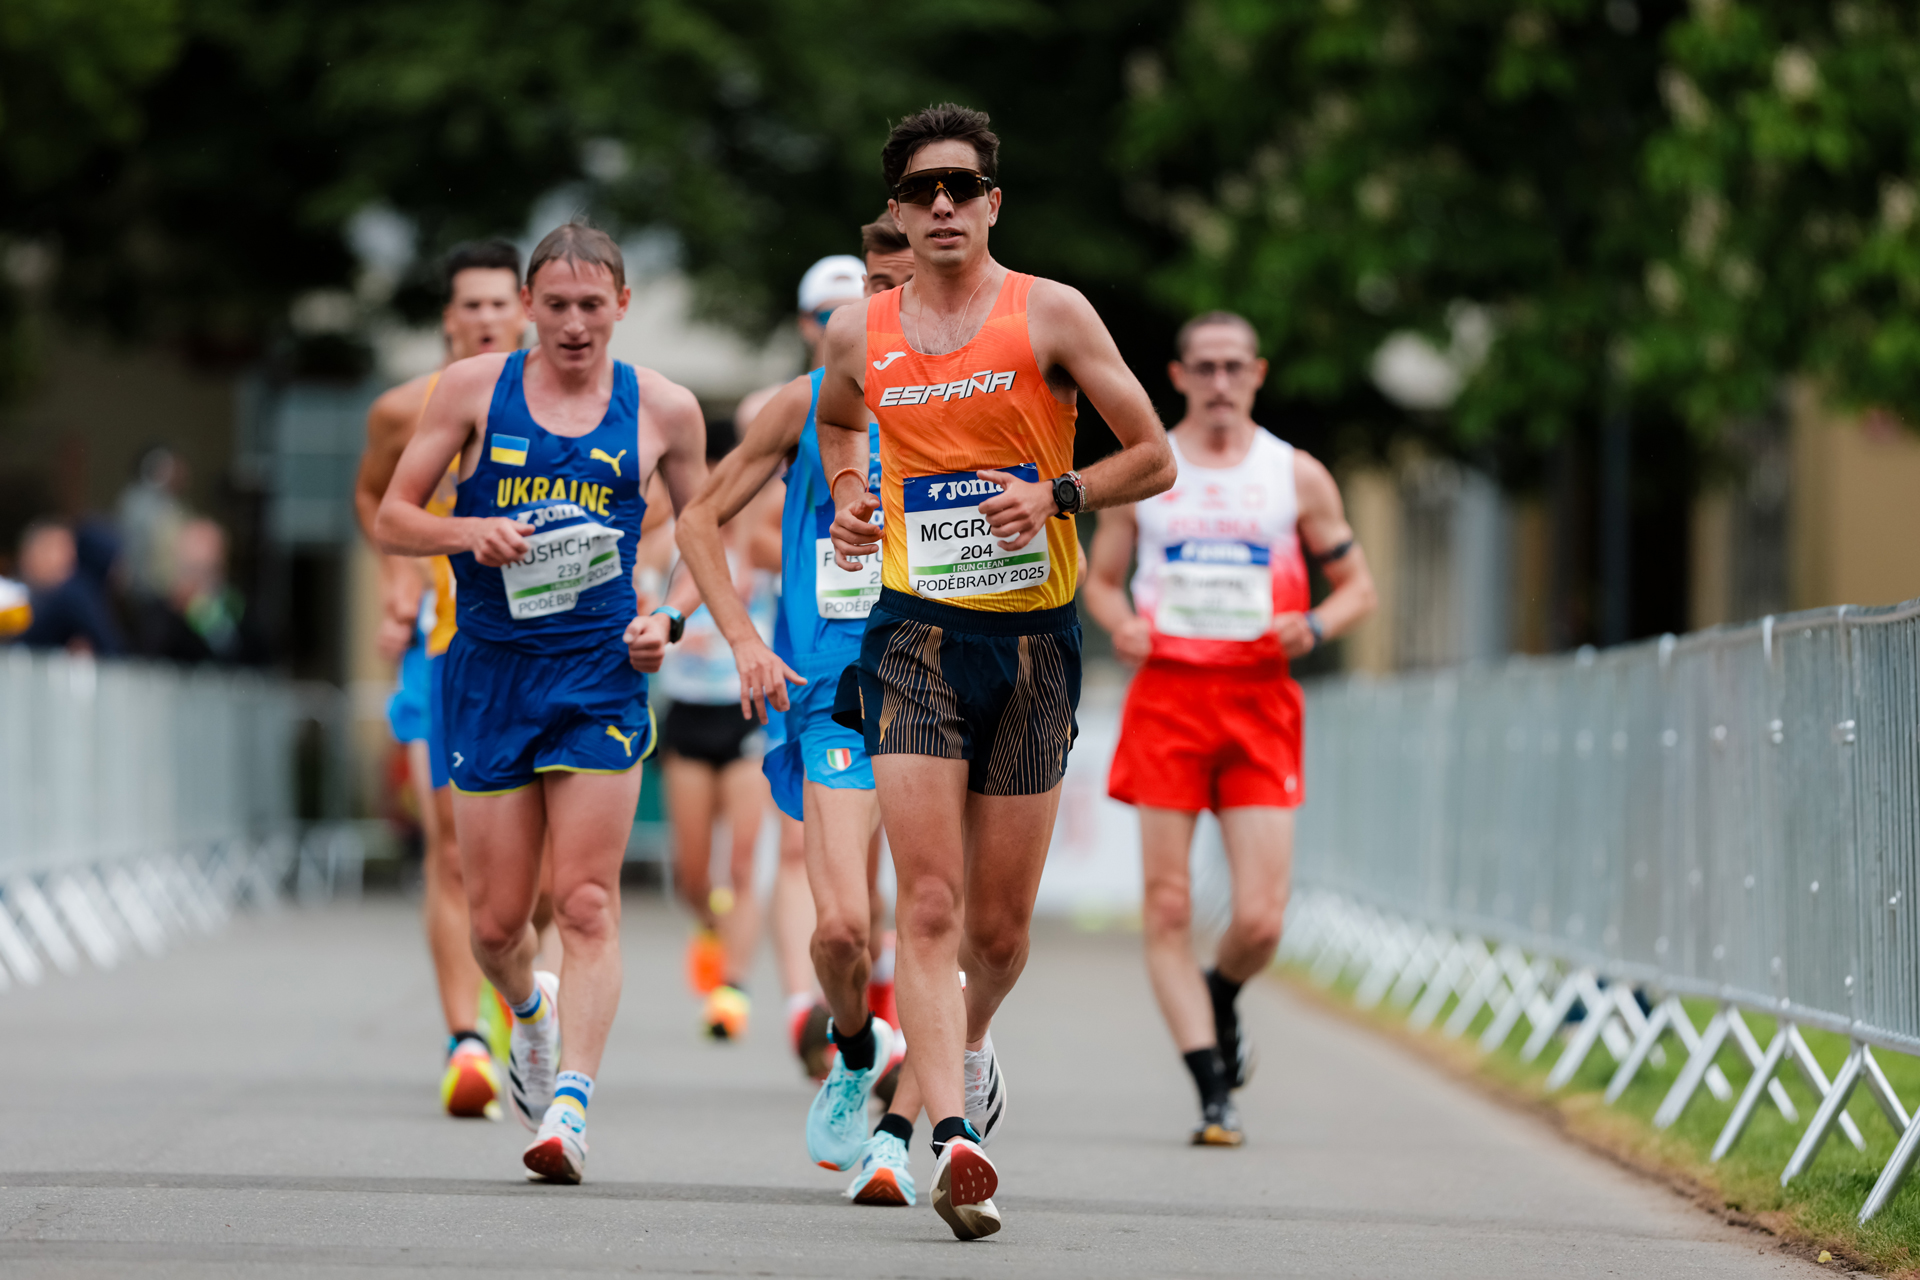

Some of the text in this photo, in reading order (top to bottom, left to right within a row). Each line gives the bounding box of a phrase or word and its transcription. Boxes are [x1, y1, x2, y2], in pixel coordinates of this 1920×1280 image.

[879, 370, 1017, 407] ESPAÑA
[496, 477, 614, 517] UKRAINE
[960, 543, 994, 560] 204
[557, 562, 582, 578] 239
[957, 562, 976, 572] RUN
[916, 566, 1045, 591] PODĚBRADY 2025
